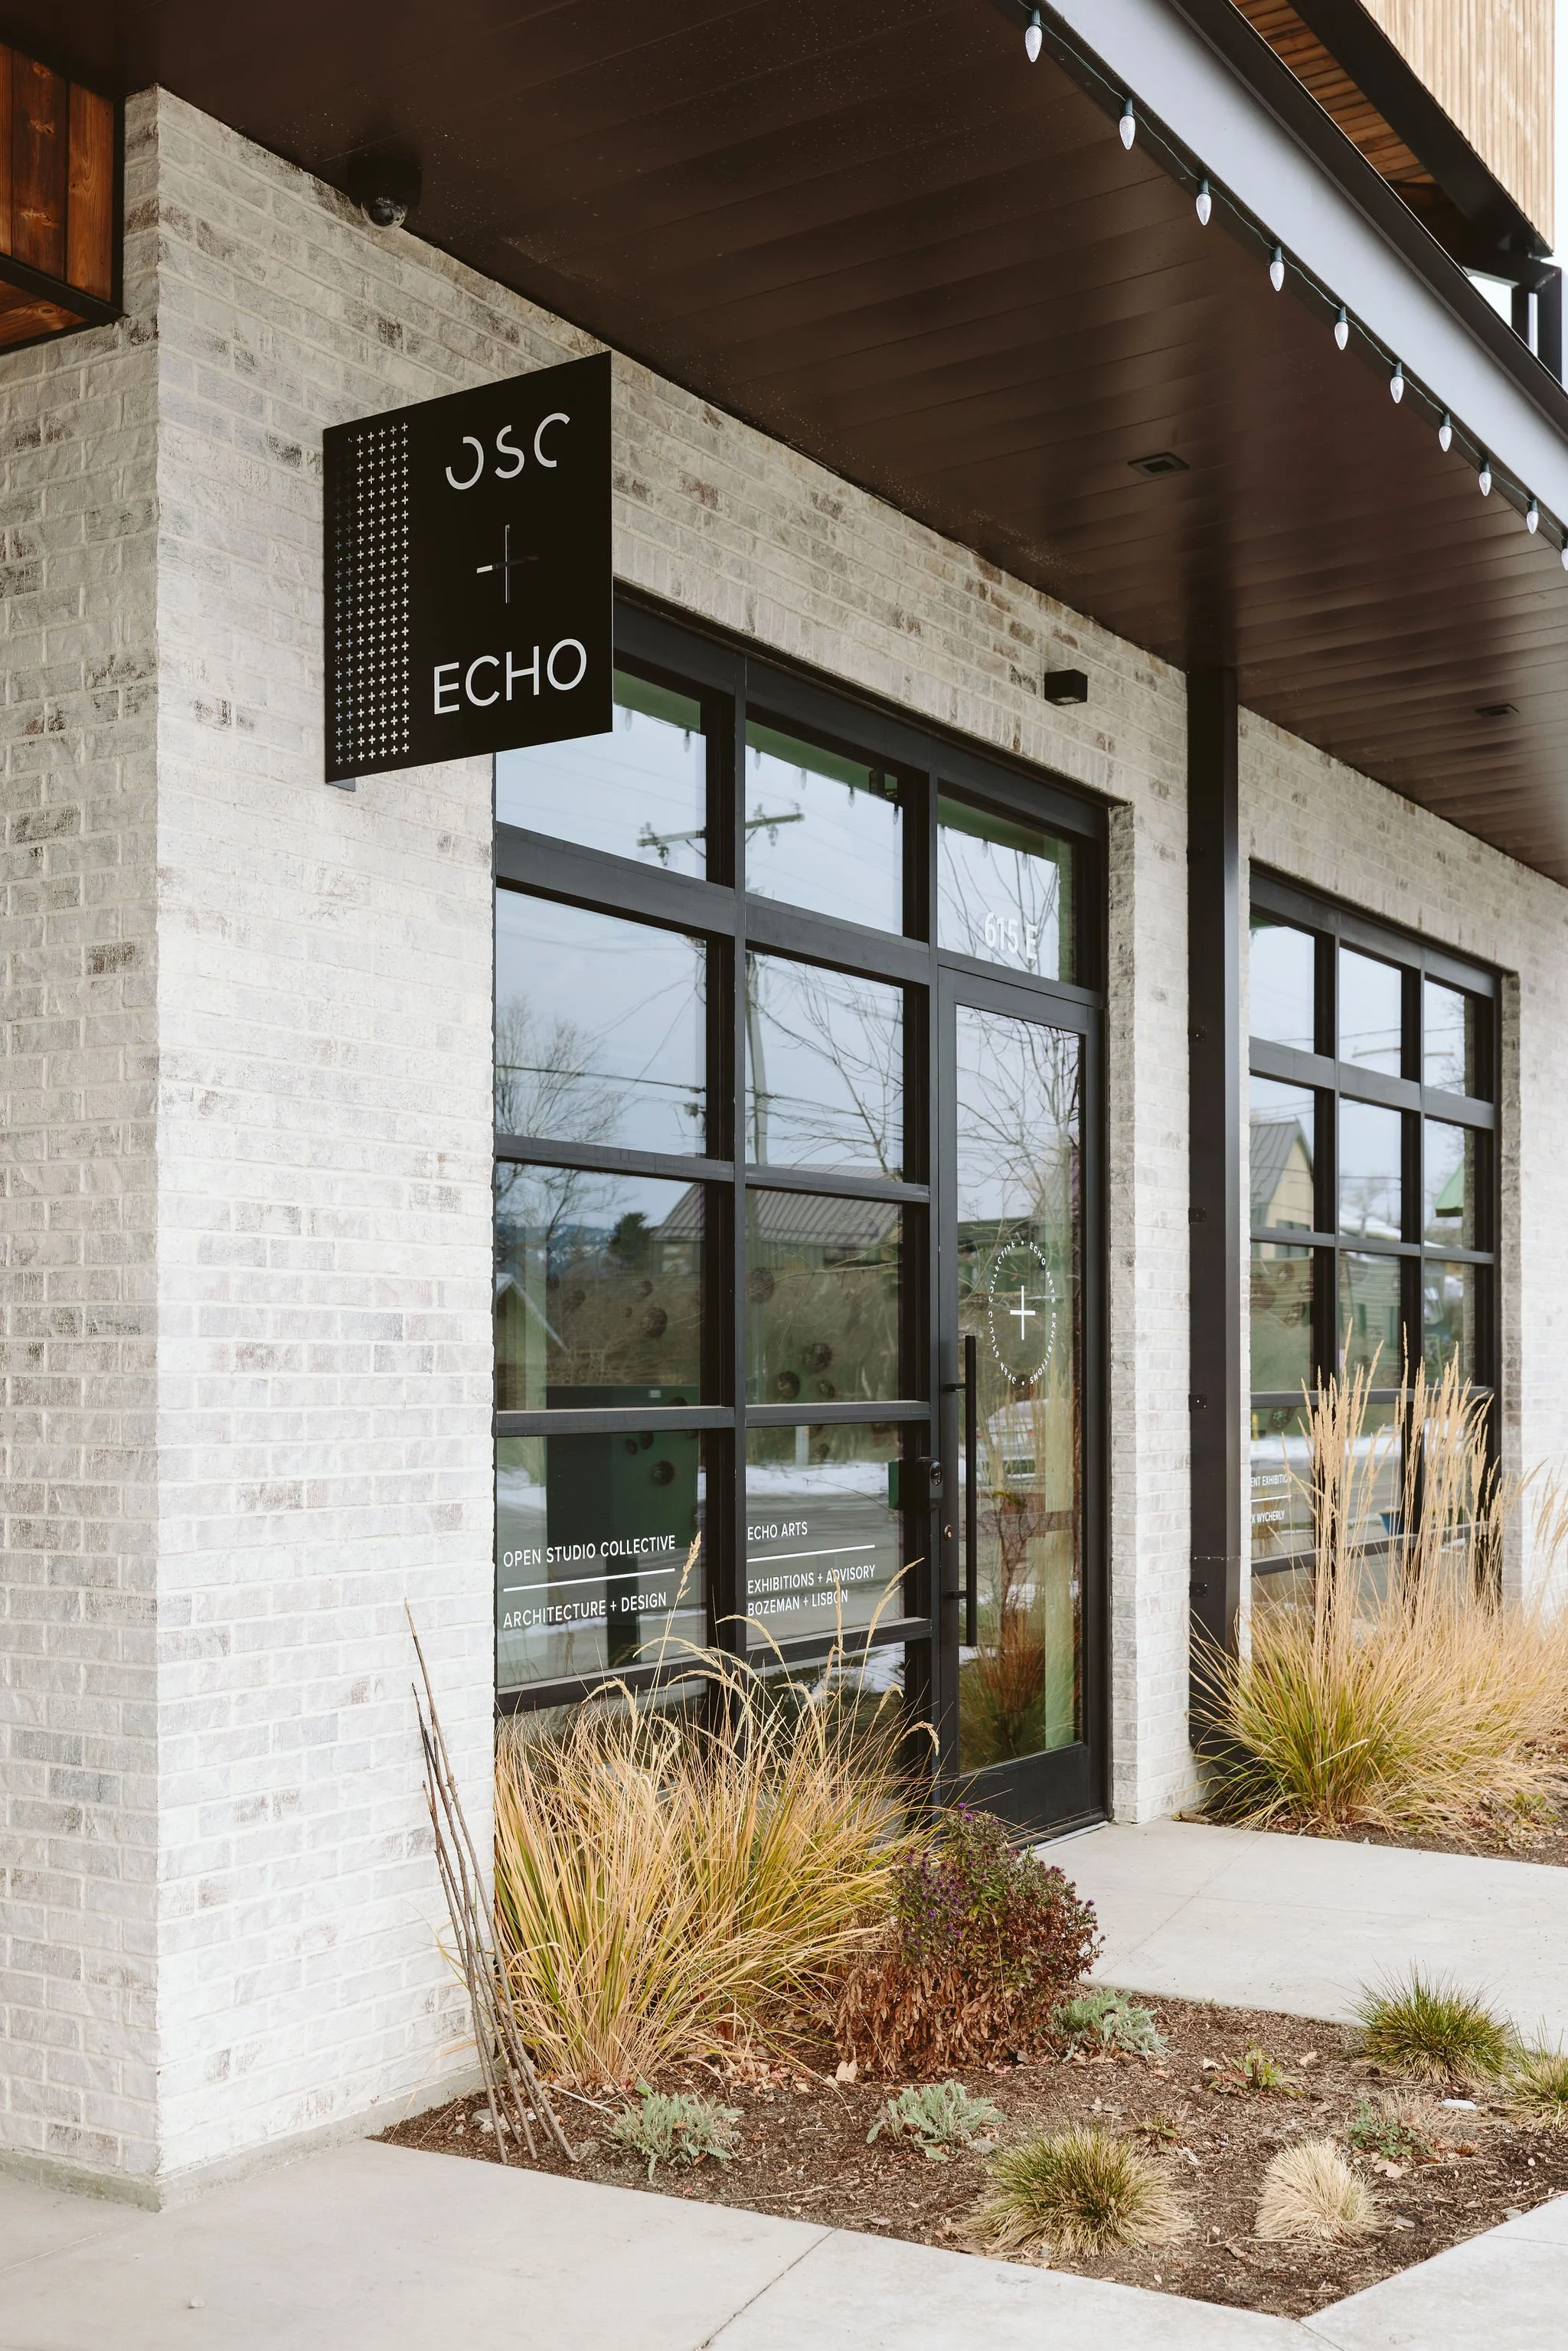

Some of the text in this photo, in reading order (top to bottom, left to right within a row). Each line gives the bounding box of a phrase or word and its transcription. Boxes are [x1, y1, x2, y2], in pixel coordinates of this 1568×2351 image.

[434, 638, 586, 715] ECHO
[985, 912, 1038, 961] 615 E
[1029, 1241, 1046, 1265] ECHO
[988, 1241, 1016, 1303] COLLECTIVE
[1029, 1312, 1057, 1385] EXHIBITIONS
[747, 1521, 808, 1541] ECHO ARTS
[1256, 1510, 1285, 1523] WYCHERLY
[503, 1535, 675, 1567] OPEN STUDIO COLLECTIVE
[747, 1572, 815, 1594] EXHIBITIONS
[826, 1565, 876, 1583] ADVISORY
[503, 1599, 606, 1628] ARCHITECTURE
[621, 1592, 667, 1612] DESIGN
[747, 1595, 800, 1617] BOZEMAN
